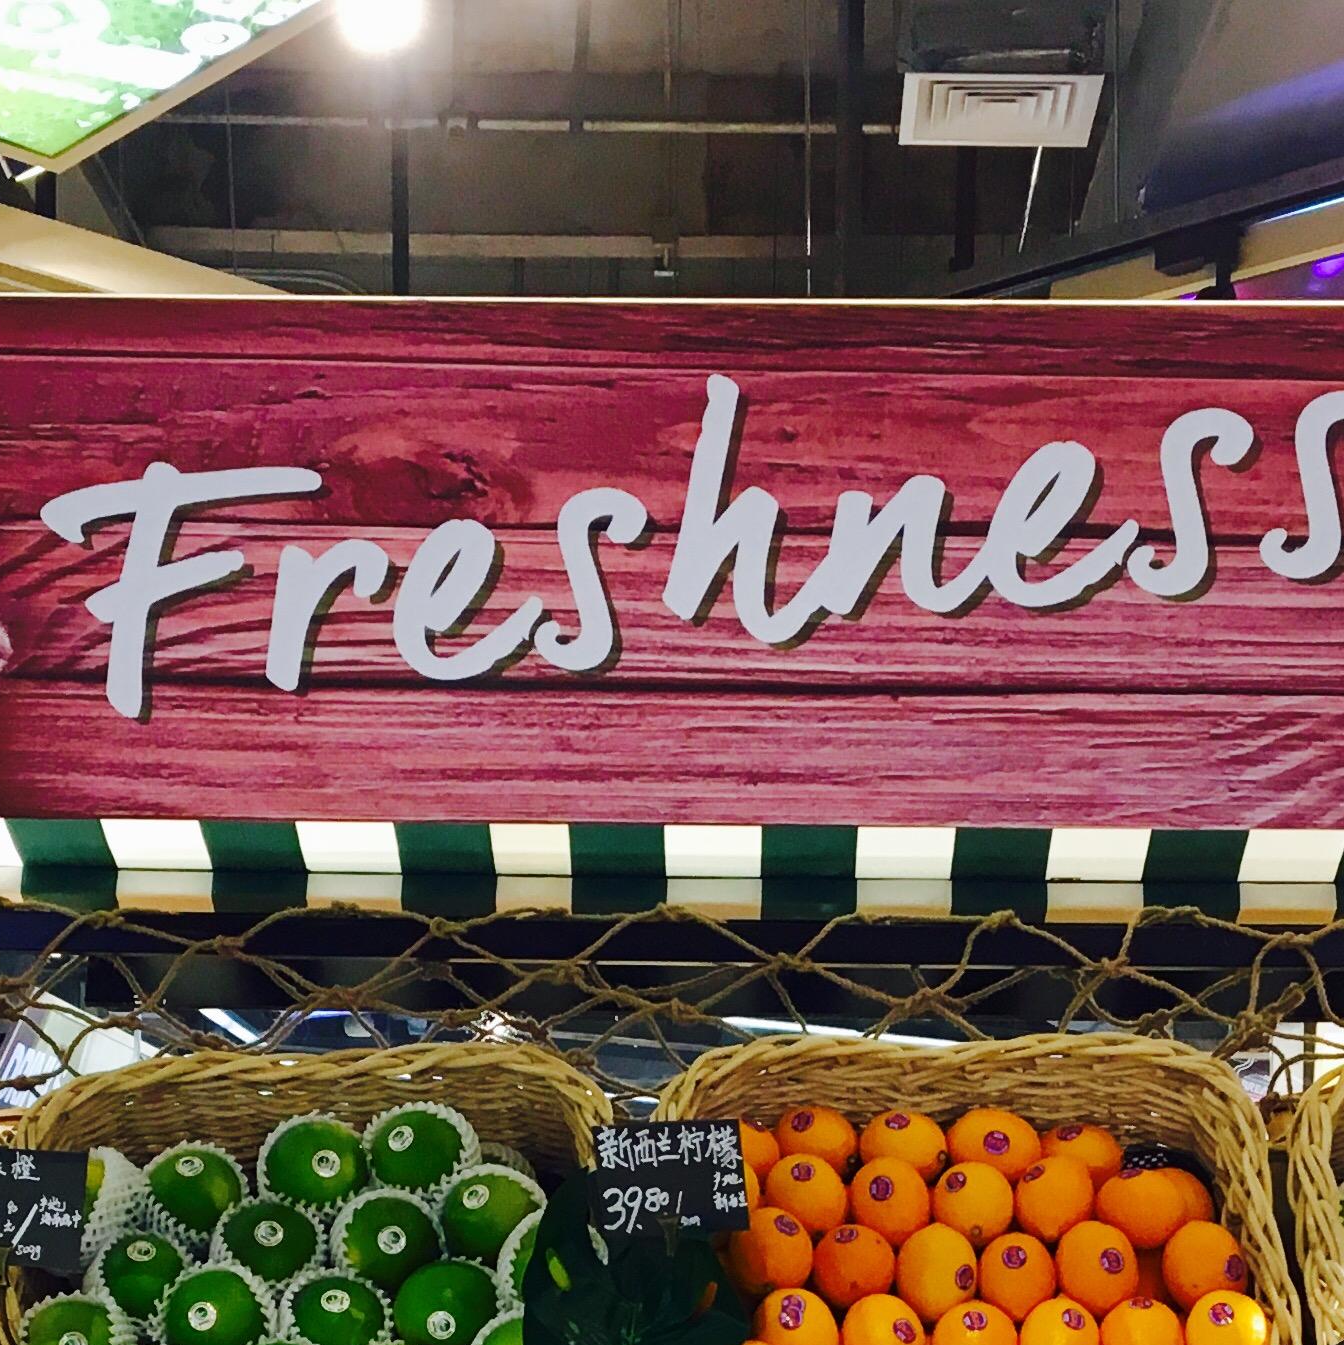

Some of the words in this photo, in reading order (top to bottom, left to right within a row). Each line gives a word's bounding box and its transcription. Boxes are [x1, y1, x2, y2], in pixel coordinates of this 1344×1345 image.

[597, 1124, 742, 1171] 新西兰柠檬
